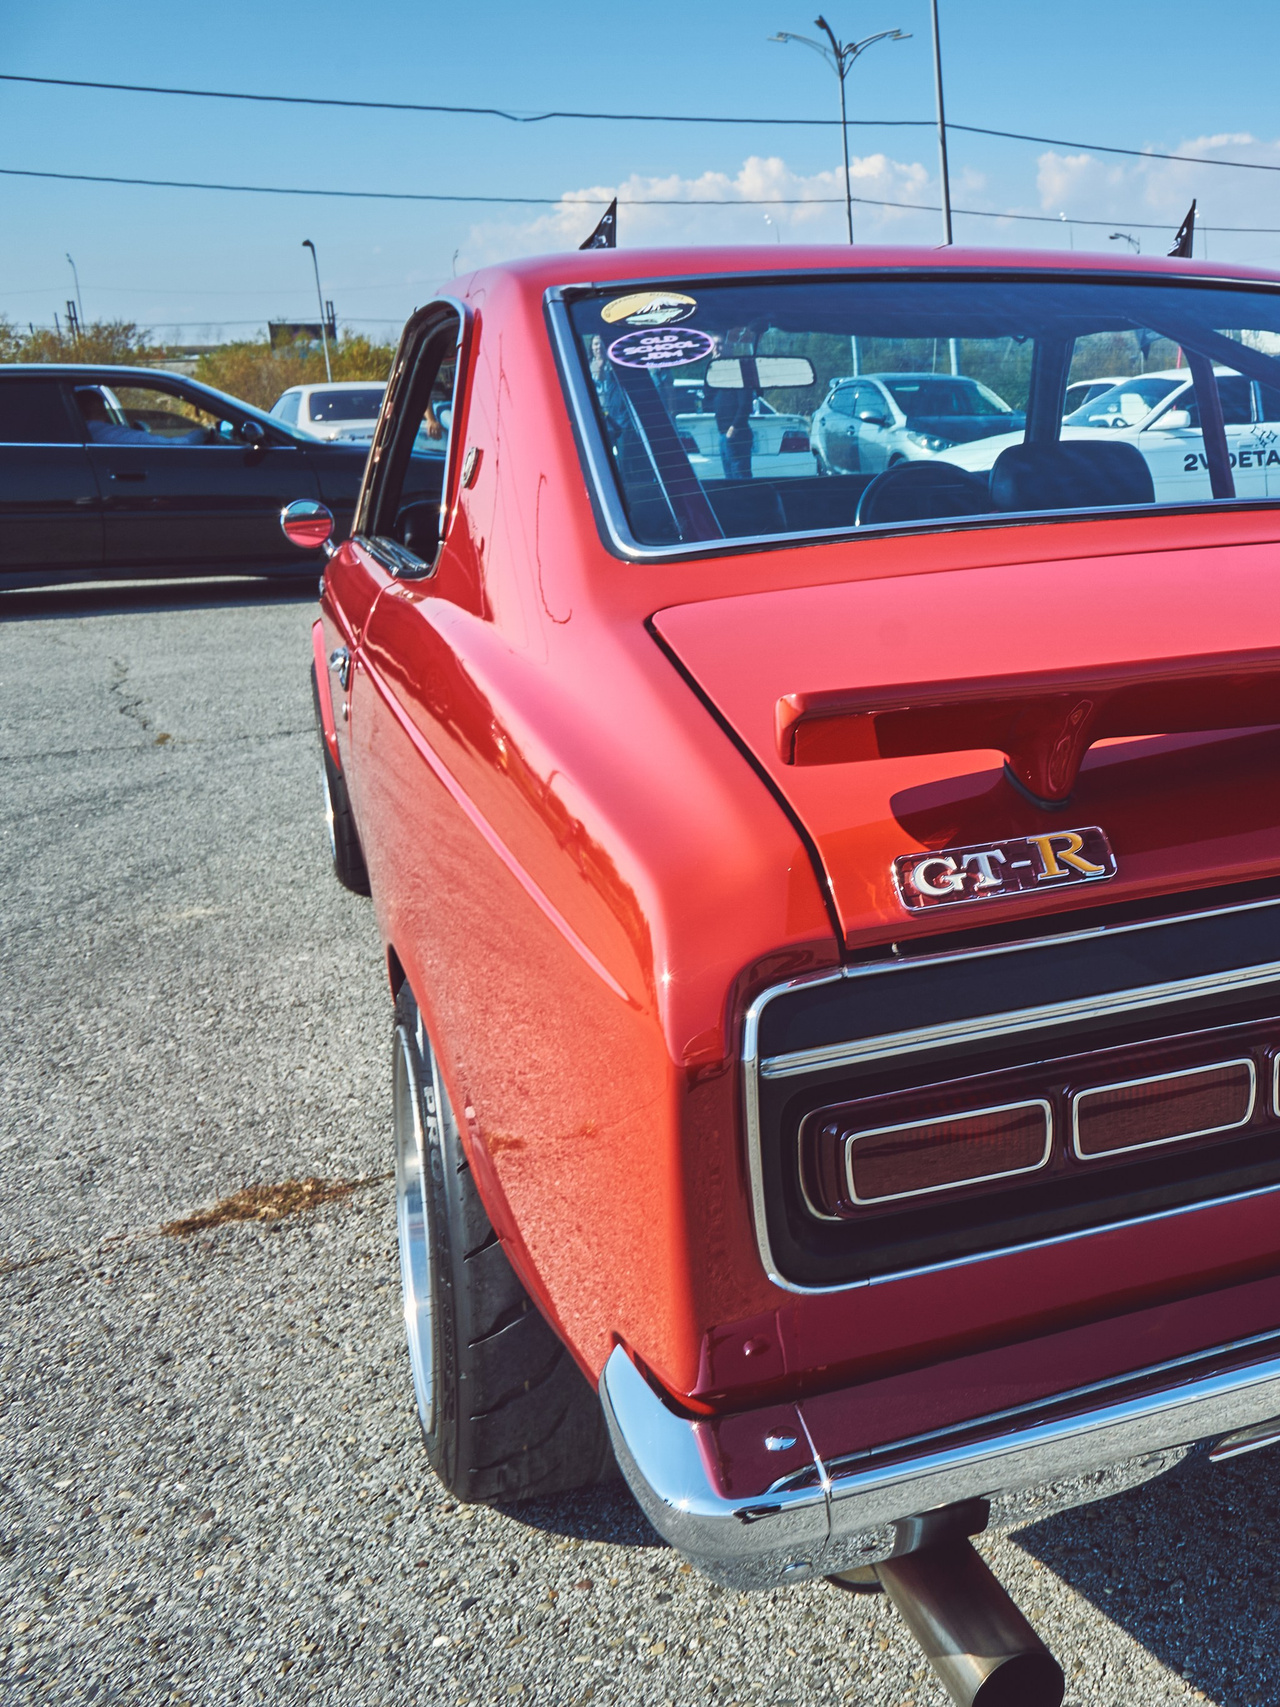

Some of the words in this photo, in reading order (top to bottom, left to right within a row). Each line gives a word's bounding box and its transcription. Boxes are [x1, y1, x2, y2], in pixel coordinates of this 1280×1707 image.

[640, 335, 679, 345] OLD
[623, 340, 700, 355] SCHOOL
[641, 349, 684, 360] JDM
[911, 832, 1106, 897] GT-R
